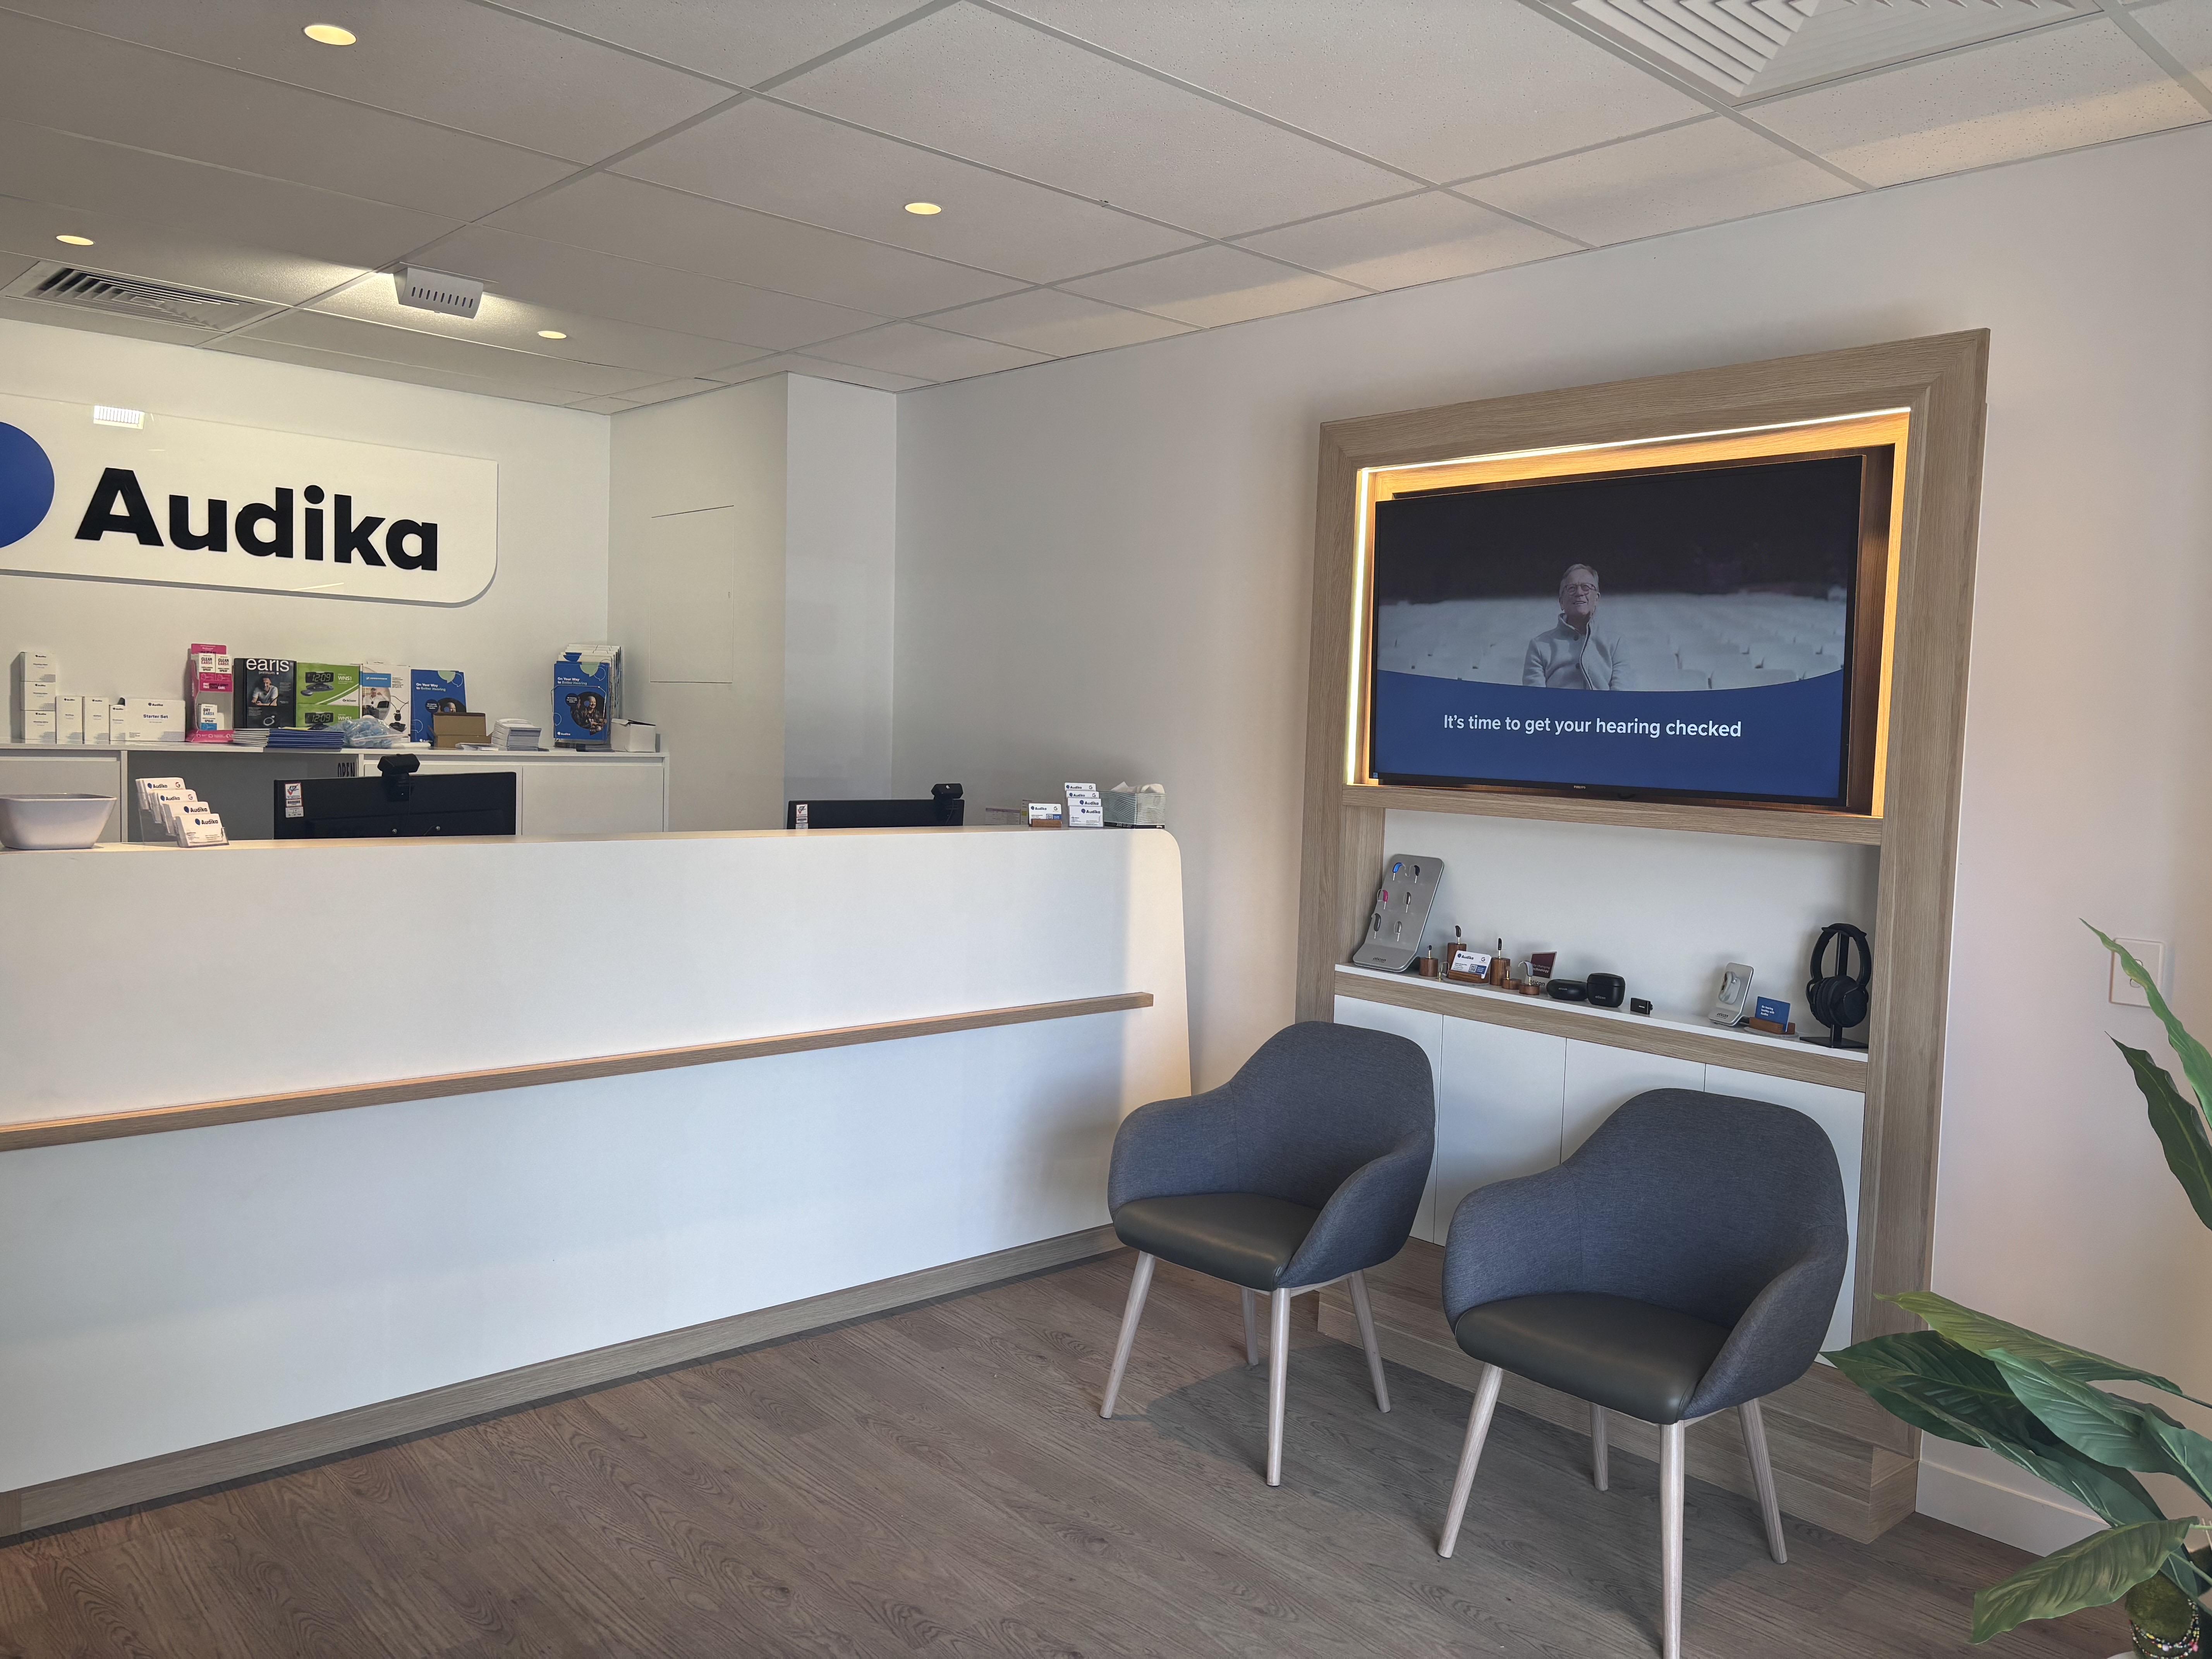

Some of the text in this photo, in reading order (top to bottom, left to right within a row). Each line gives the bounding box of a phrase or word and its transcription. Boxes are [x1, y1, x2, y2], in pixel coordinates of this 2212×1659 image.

[75, 467, 438, 571] Audika
[1444, 714, 1741, 738] It’s time to get your hearing checked
